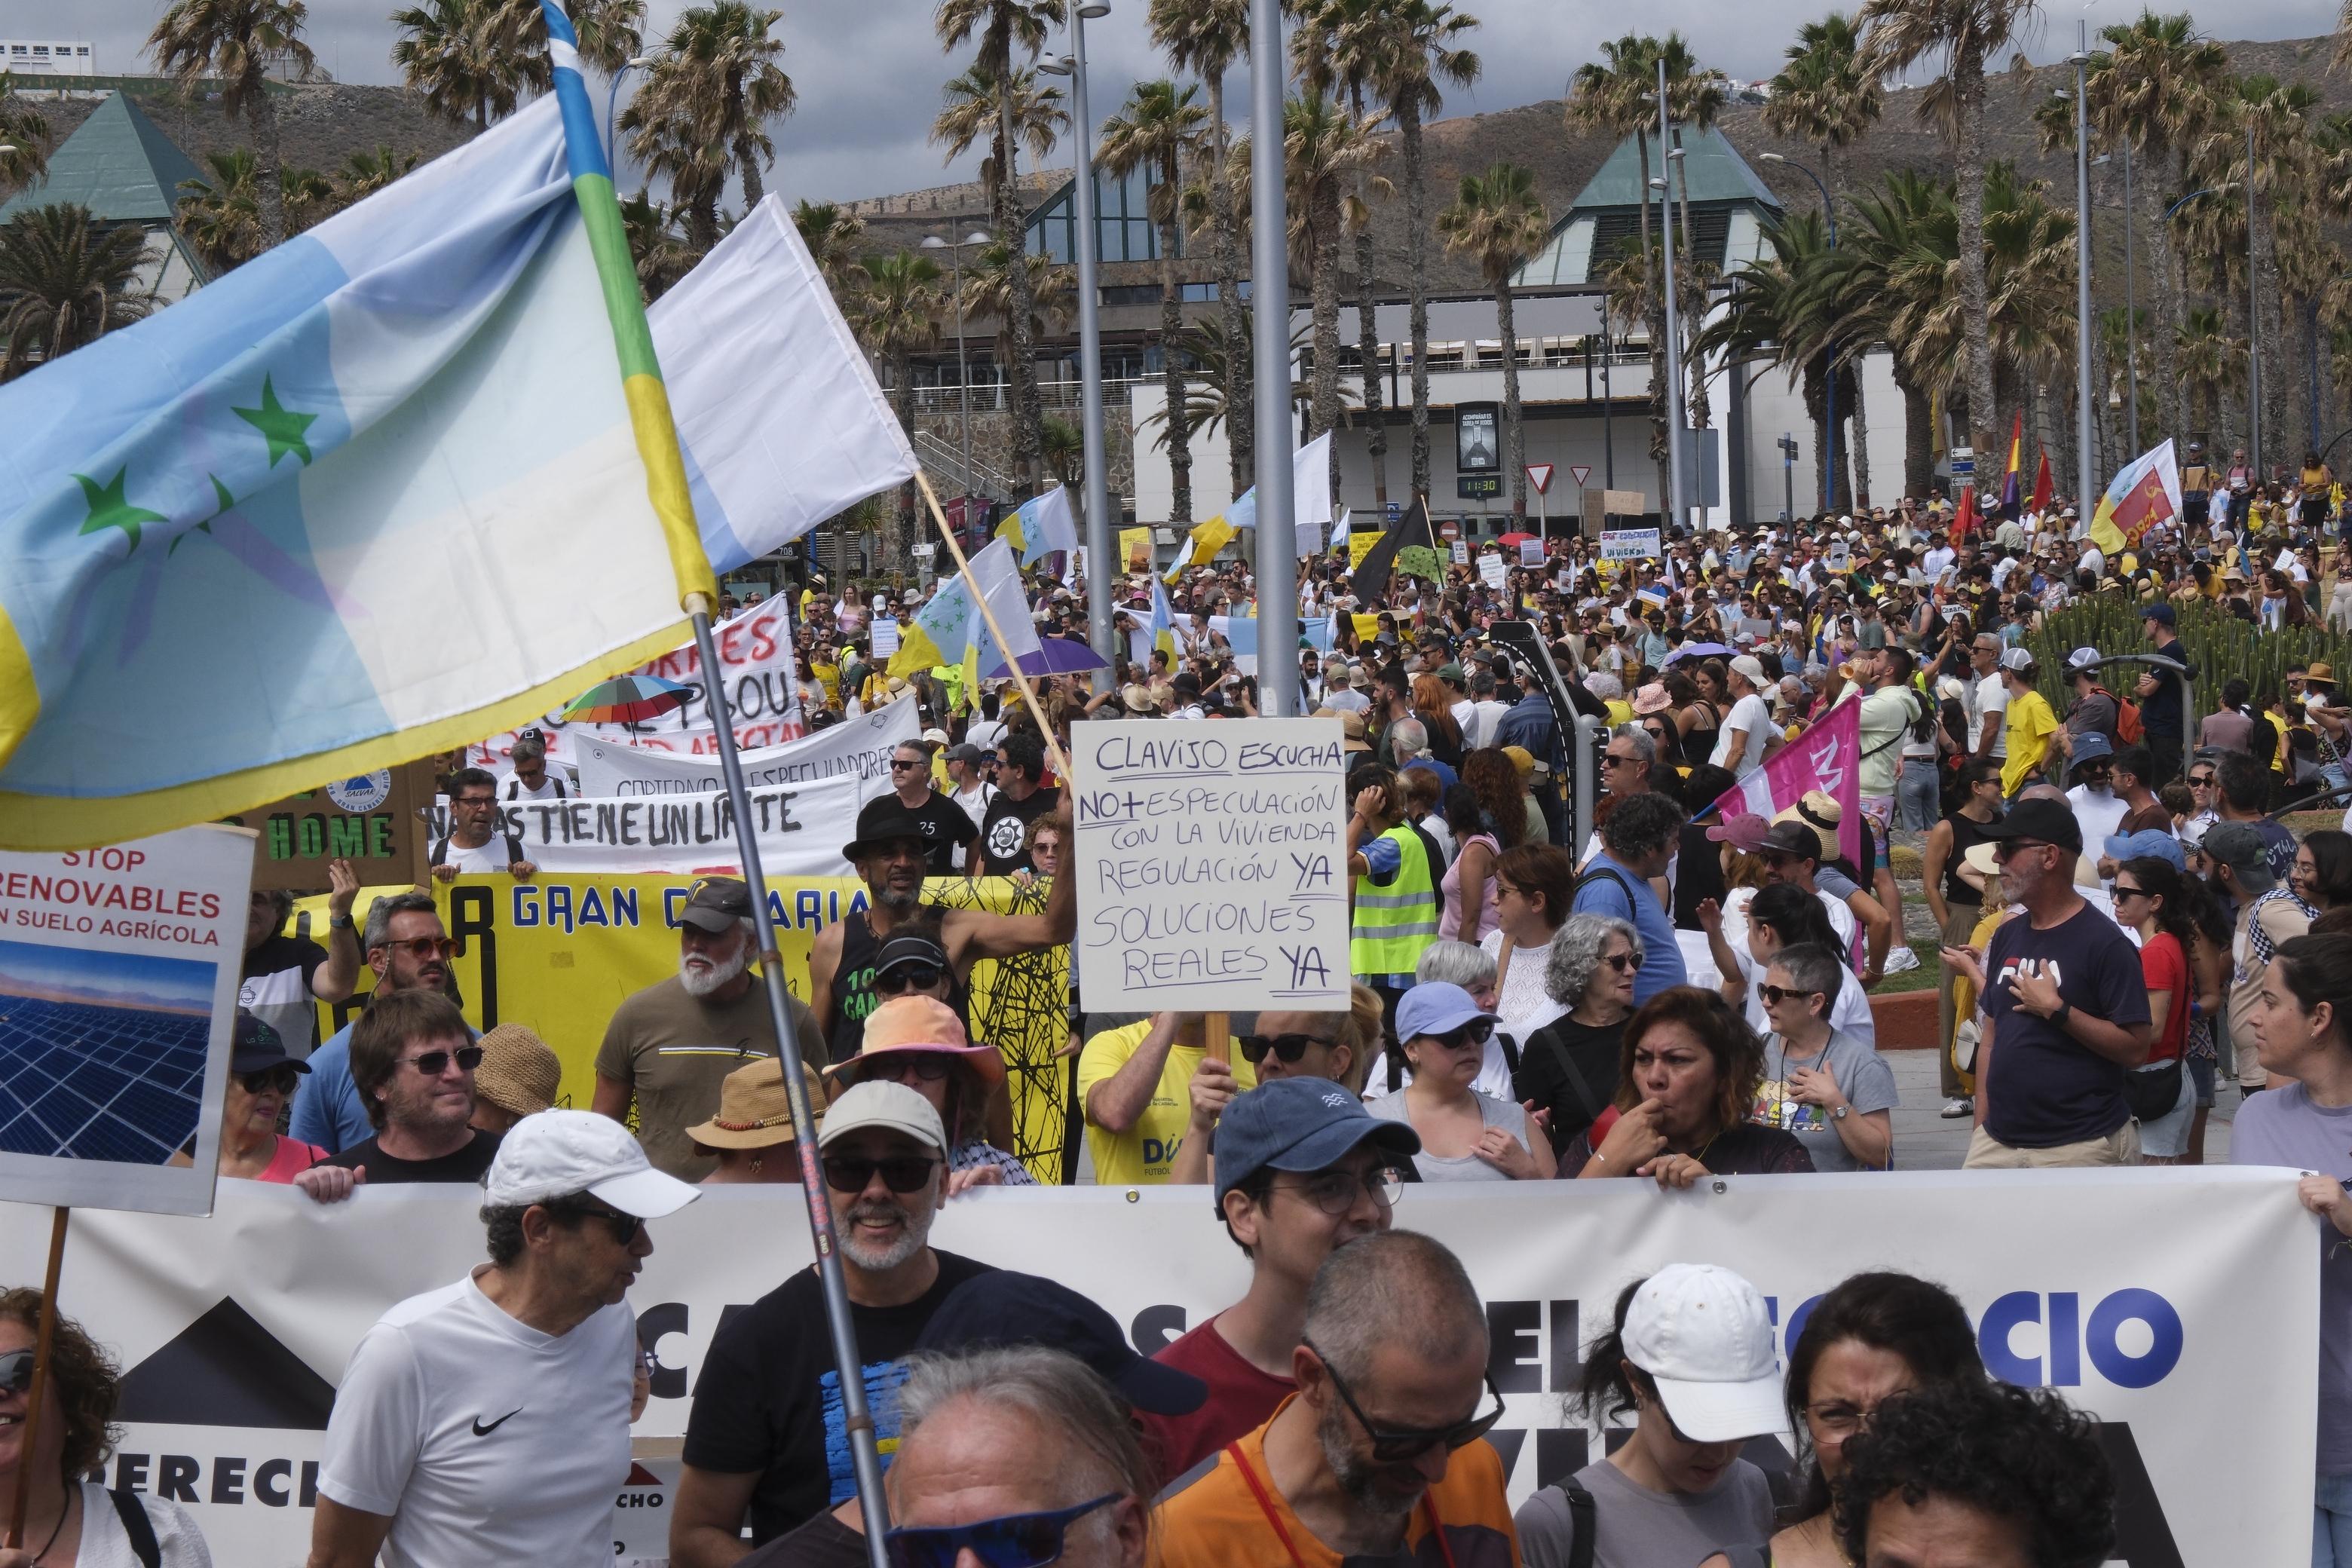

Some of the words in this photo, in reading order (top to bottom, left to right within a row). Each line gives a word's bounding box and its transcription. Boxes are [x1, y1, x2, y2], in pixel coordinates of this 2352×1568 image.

[1467, 480, 1496, 491] 11:30
[779, 547, 793, 556] 708
[1238, 742, 1342, 770] ESCUCHA
[337, 799, 355, 810] GRAN
[358, 794, 385, 811] CANARIA
[345, 788, 376, 798] SALVAR
[267, 813, 396, 860] HOME
[1111, 824, 1158, 850] CON
[1176, 821, 1202, 844] LA
[62, 847, 145, 873] STOP
[1290, 853, 1333, 890] YA
[0, 872, 221, 919] ENOVABLES
[512, 885, 640, 935] GRAN
[16, 909, 93, 933] SUELO
[100, 919, 219, 946] AGRÍCOLA
[1122, 945, 1268, 987] REALES
[1279, 945, 1331, 990] YA
